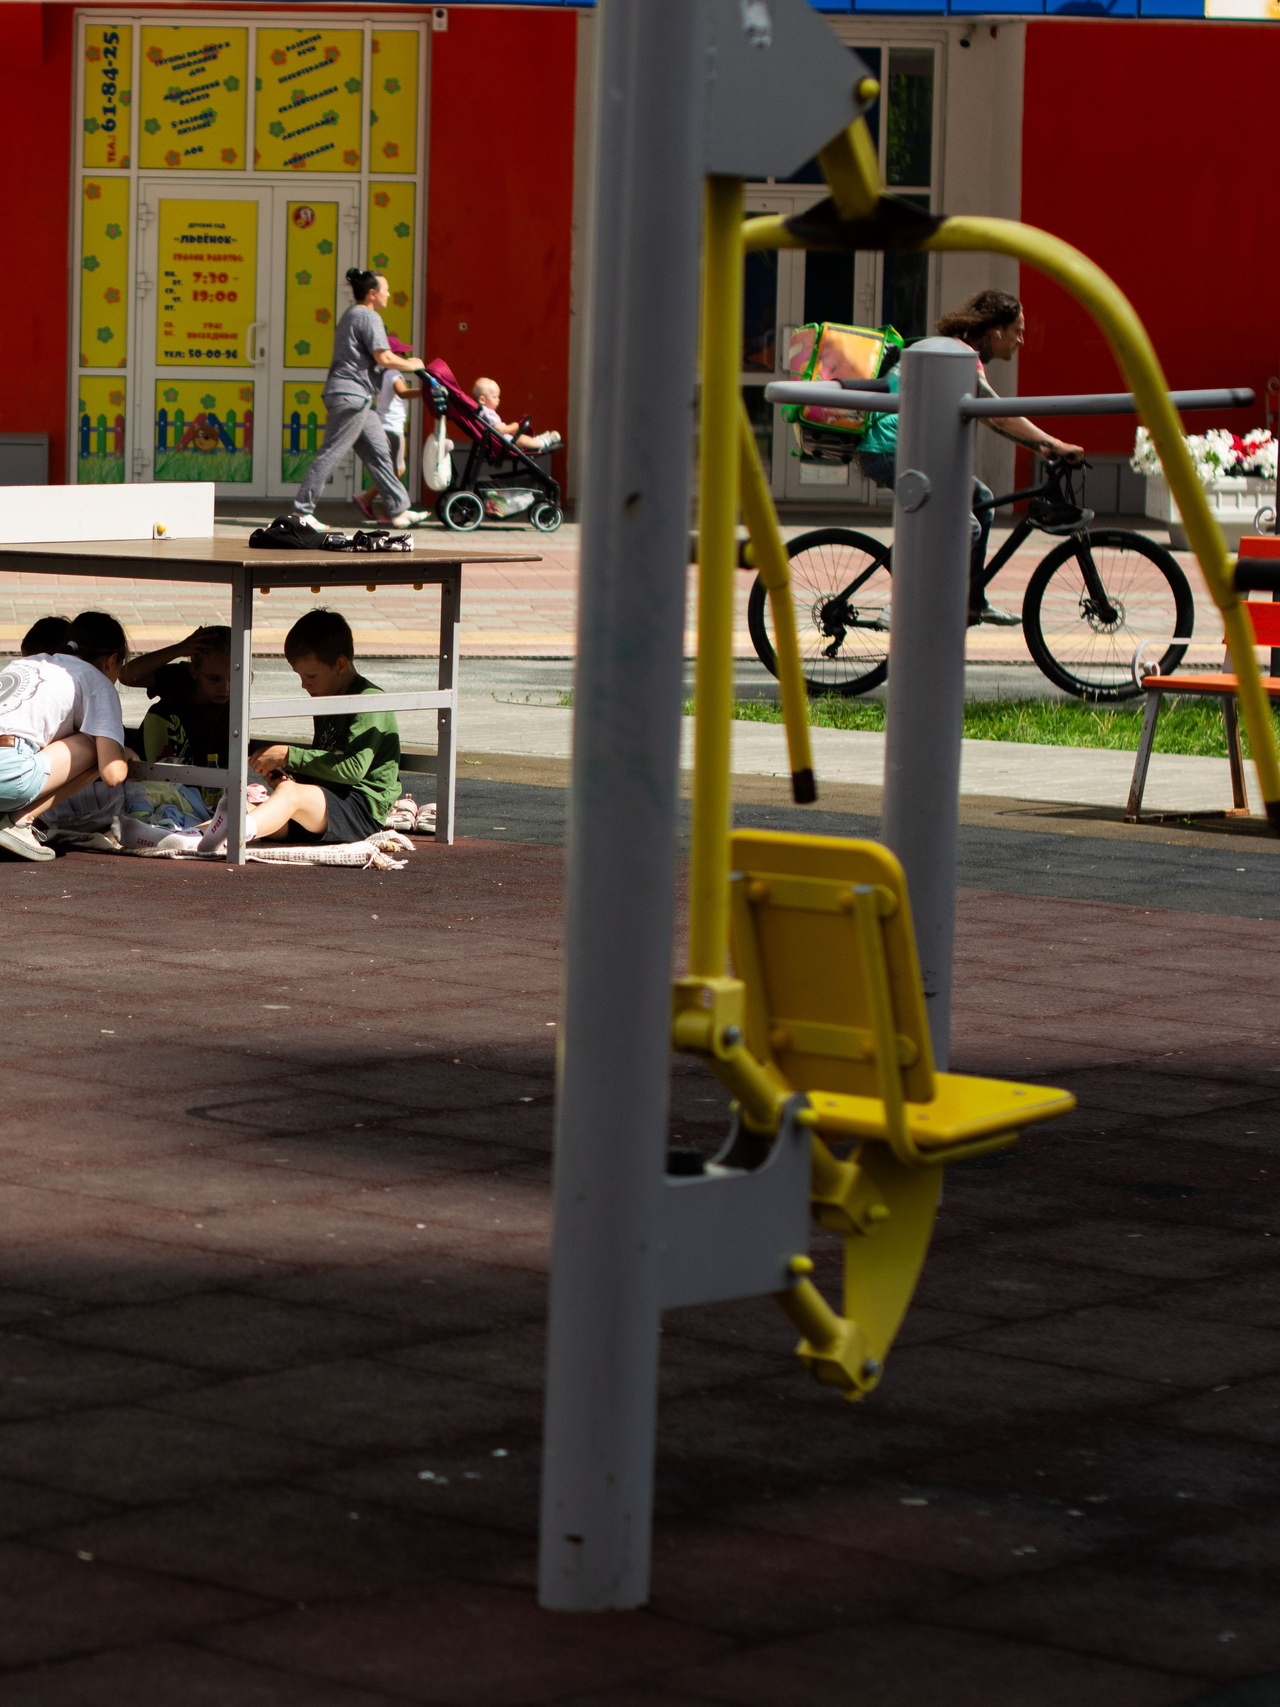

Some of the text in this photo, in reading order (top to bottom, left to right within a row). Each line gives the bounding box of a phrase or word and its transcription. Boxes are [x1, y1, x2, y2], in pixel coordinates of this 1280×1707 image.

[285, 34, 322, 52] РАЗВИТИЕ
[155, 53, 186, 67] ГРУППЫ
[187, 43, 223, 58] ПОЛНОГО
[171, 54, 218, 71] НЕПОЛНОГО
[278, 58, 334, 84] ПЕСКОТЕРАПИЯ
[101, 31, 120, 132] 61-84-25
[179, 92, 210, 106] ОСМОТР
[278, 85, 338, 113] СКАЗКОТЕРАПИЯ
[177, 121, 212, 135] ПИТАНИЕ
[184, 145, 204, 156] ЛФК
[173, 253, 204, 262] ГРАФИК
[192, 271, 229, 284] 7:30
[192, 289, 238, 303] 19:00
[186, 332, 238, 341] ВЫХОДНЫЕ
[188, 349, 238, 359] 50-00-96
[211, 814, 224, 834] SPORT
